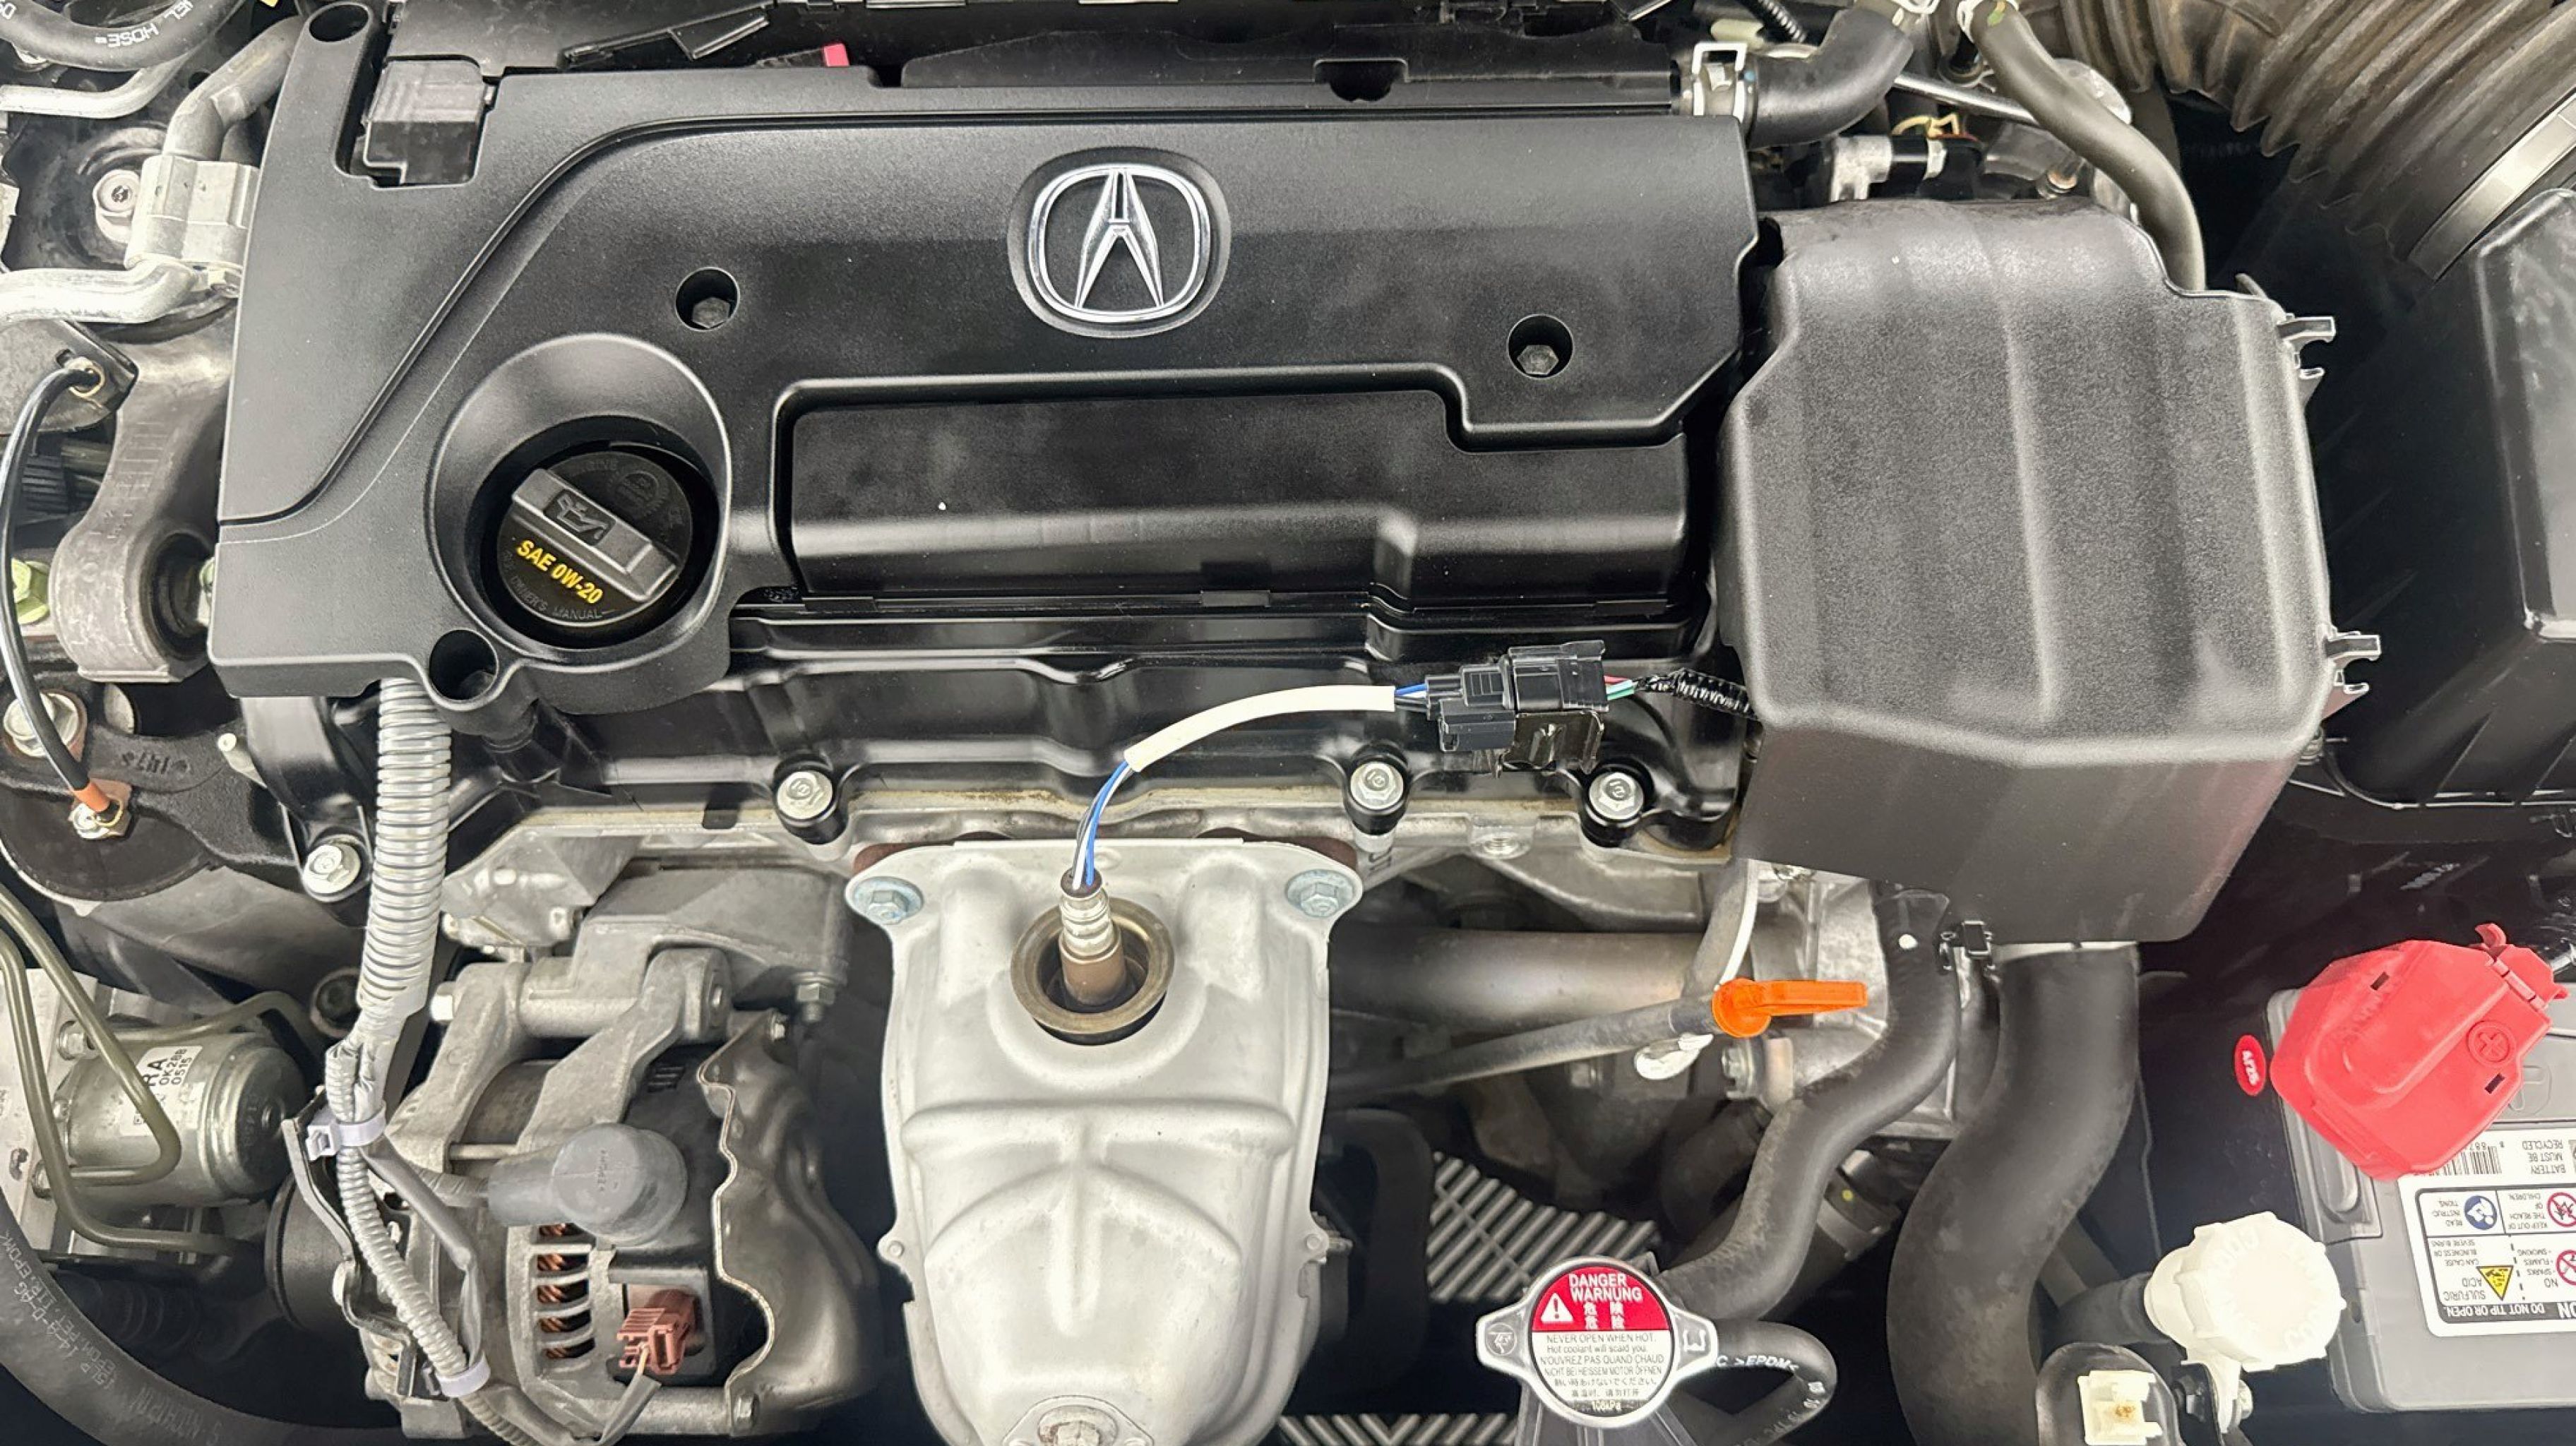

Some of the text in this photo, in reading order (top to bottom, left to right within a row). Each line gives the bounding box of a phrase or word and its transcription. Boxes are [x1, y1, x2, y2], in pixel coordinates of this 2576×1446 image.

[517, 540, 556, 571] SAE
[551, 564, 603, 604] 0W-20
[2522, 1140, 2564, 1150] RECYCLED
[2528, 1152, 2563, 1162] MUST BE
[2530, 1164, 2567, 1174] BATTERY
[1568, 1273, 1628, 1287] DANGER
[2462, 1278, 2482, 1287] ACID
[2544, 1278, 2558, 1288] NO
[1570, 1287, 1643, 1302] WARNUNG
[2443, 1290, 2486, 1301] SULFURIC
[2474, 1305, 2488, 1316] OR
[2491, 1305, 2507, 1315] TIP
[2510, 1304, 2529, 1315] NOT
[2531, 1303, 2545, 1314] DO
[1547, 1334, 1577, 1343] NEVER
[1580, 1334, 1604, 1342] OPEN
[1563, 1344, 1592, 1354] coolant
[1585, 1355, 1601, 1363] PAS
[1603, 1356, 1632, 1364] QUAND
[1635, 1355, 1664, 1363] CHAUD
